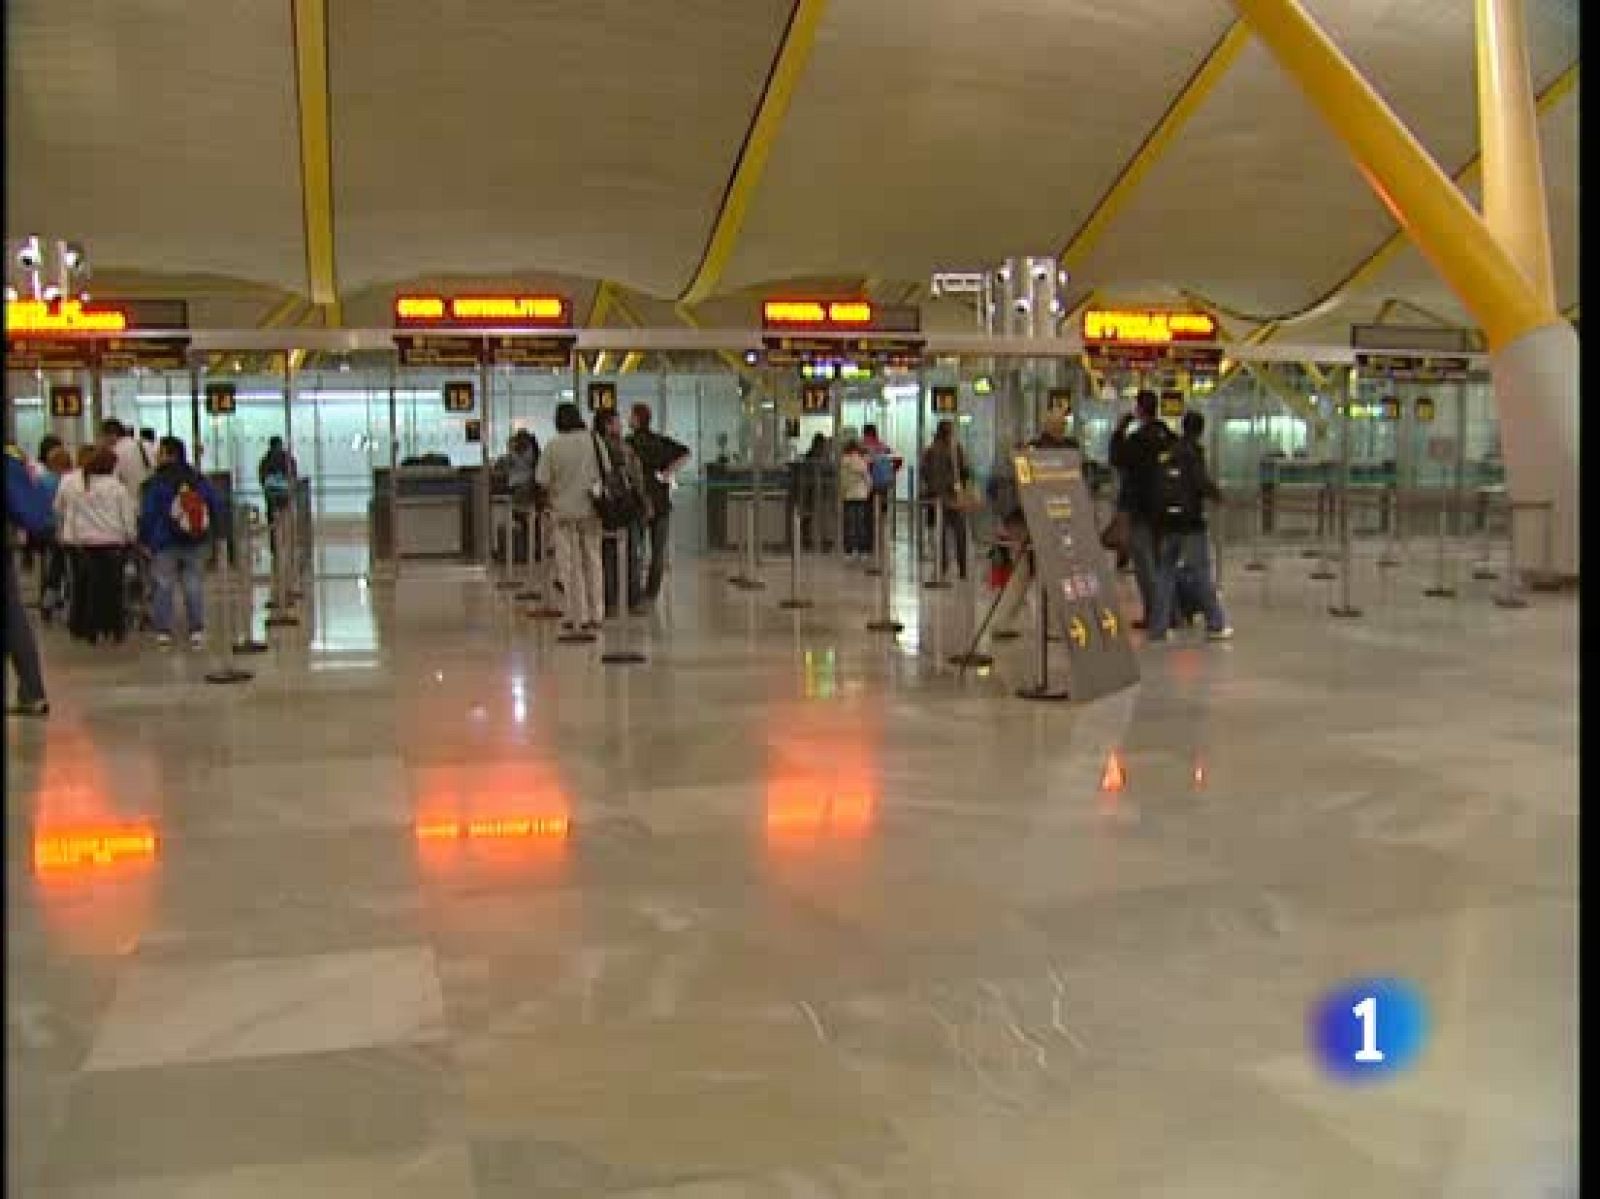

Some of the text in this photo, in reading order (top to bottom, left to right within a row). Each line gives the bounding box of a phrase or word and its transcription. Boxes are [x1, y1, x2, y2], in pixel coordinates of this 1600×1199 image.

[57, 395, 79, 414] 13
[212, 394, 231, 409] 14
[450, 389, 470, 409] 15
[593, 390, 612, 409] 16
[807, 390, 825, 409] 17
